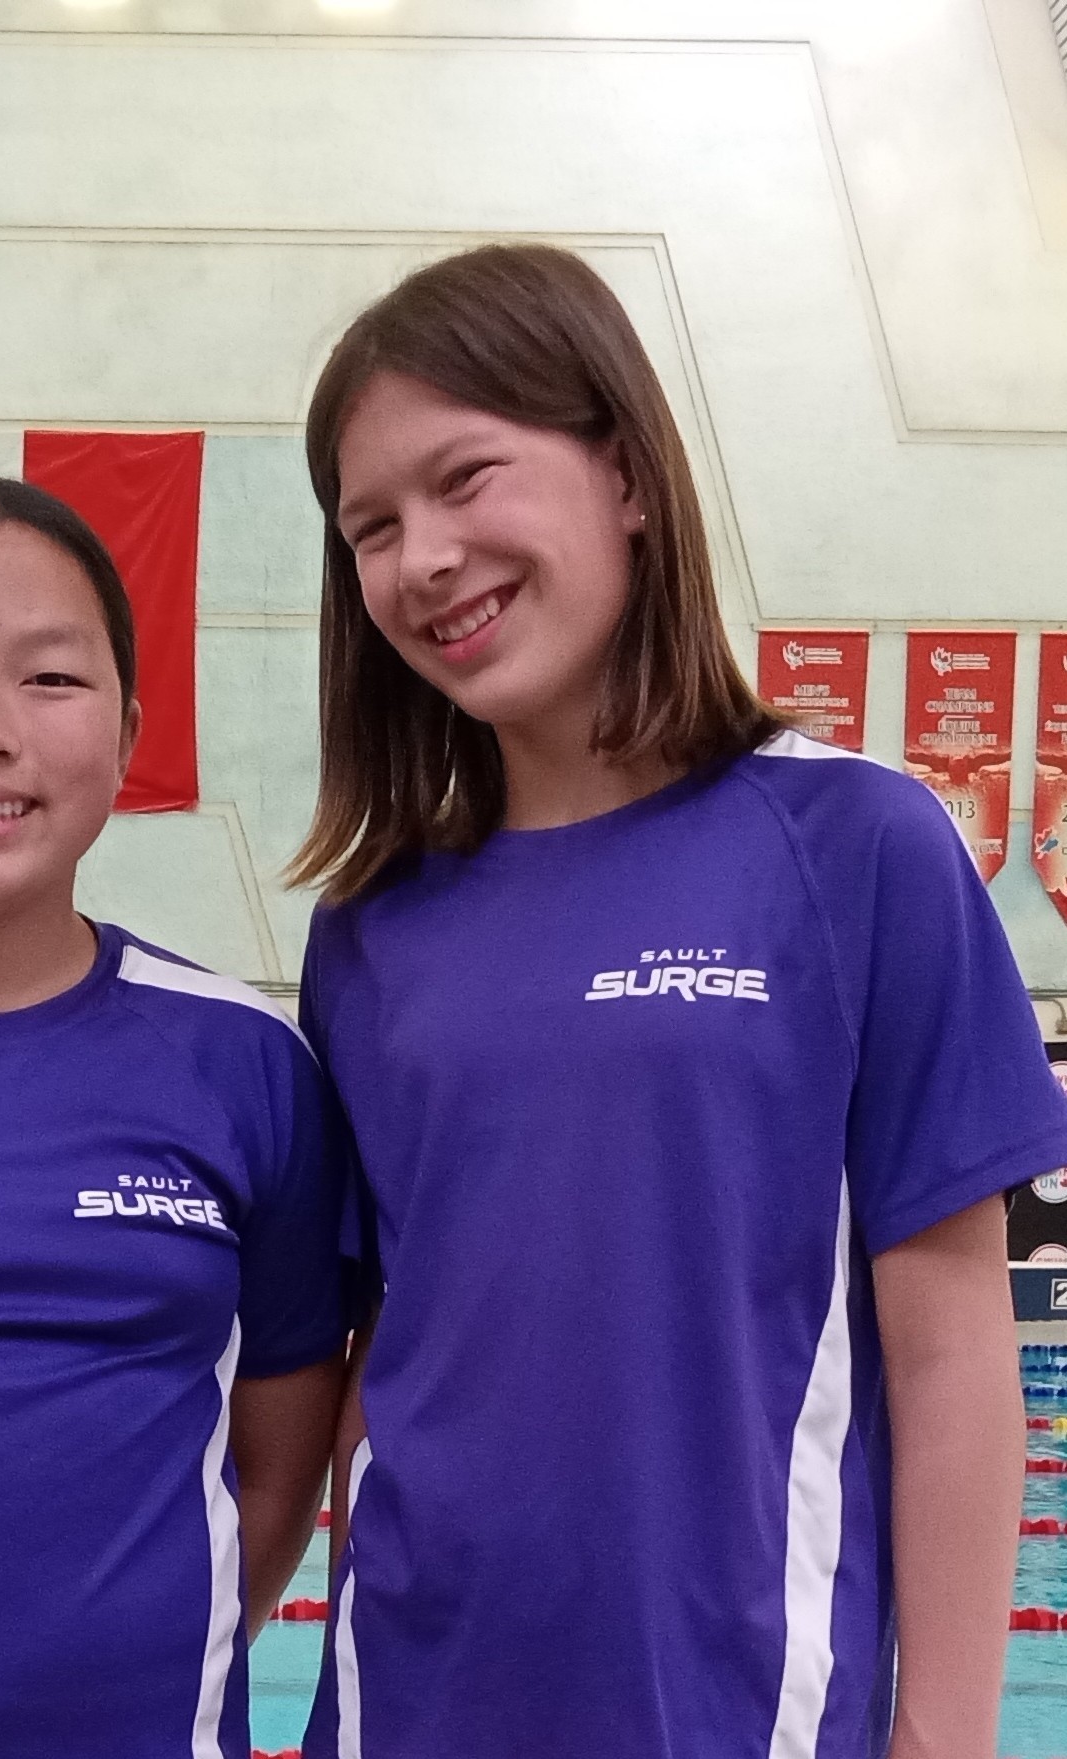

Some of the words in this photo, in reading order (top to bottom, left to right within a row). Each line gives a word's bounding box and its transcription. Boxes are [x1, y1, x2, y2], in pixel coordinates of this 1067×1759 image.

[944, 800, 976, 819] 013
[639, 949, 727, 963] SAULT
[585, 967, 770, 1002] SURGE
[117, 1174, 192, 1192] SAULT
[73, 1190, 227, 1231] SURGE
